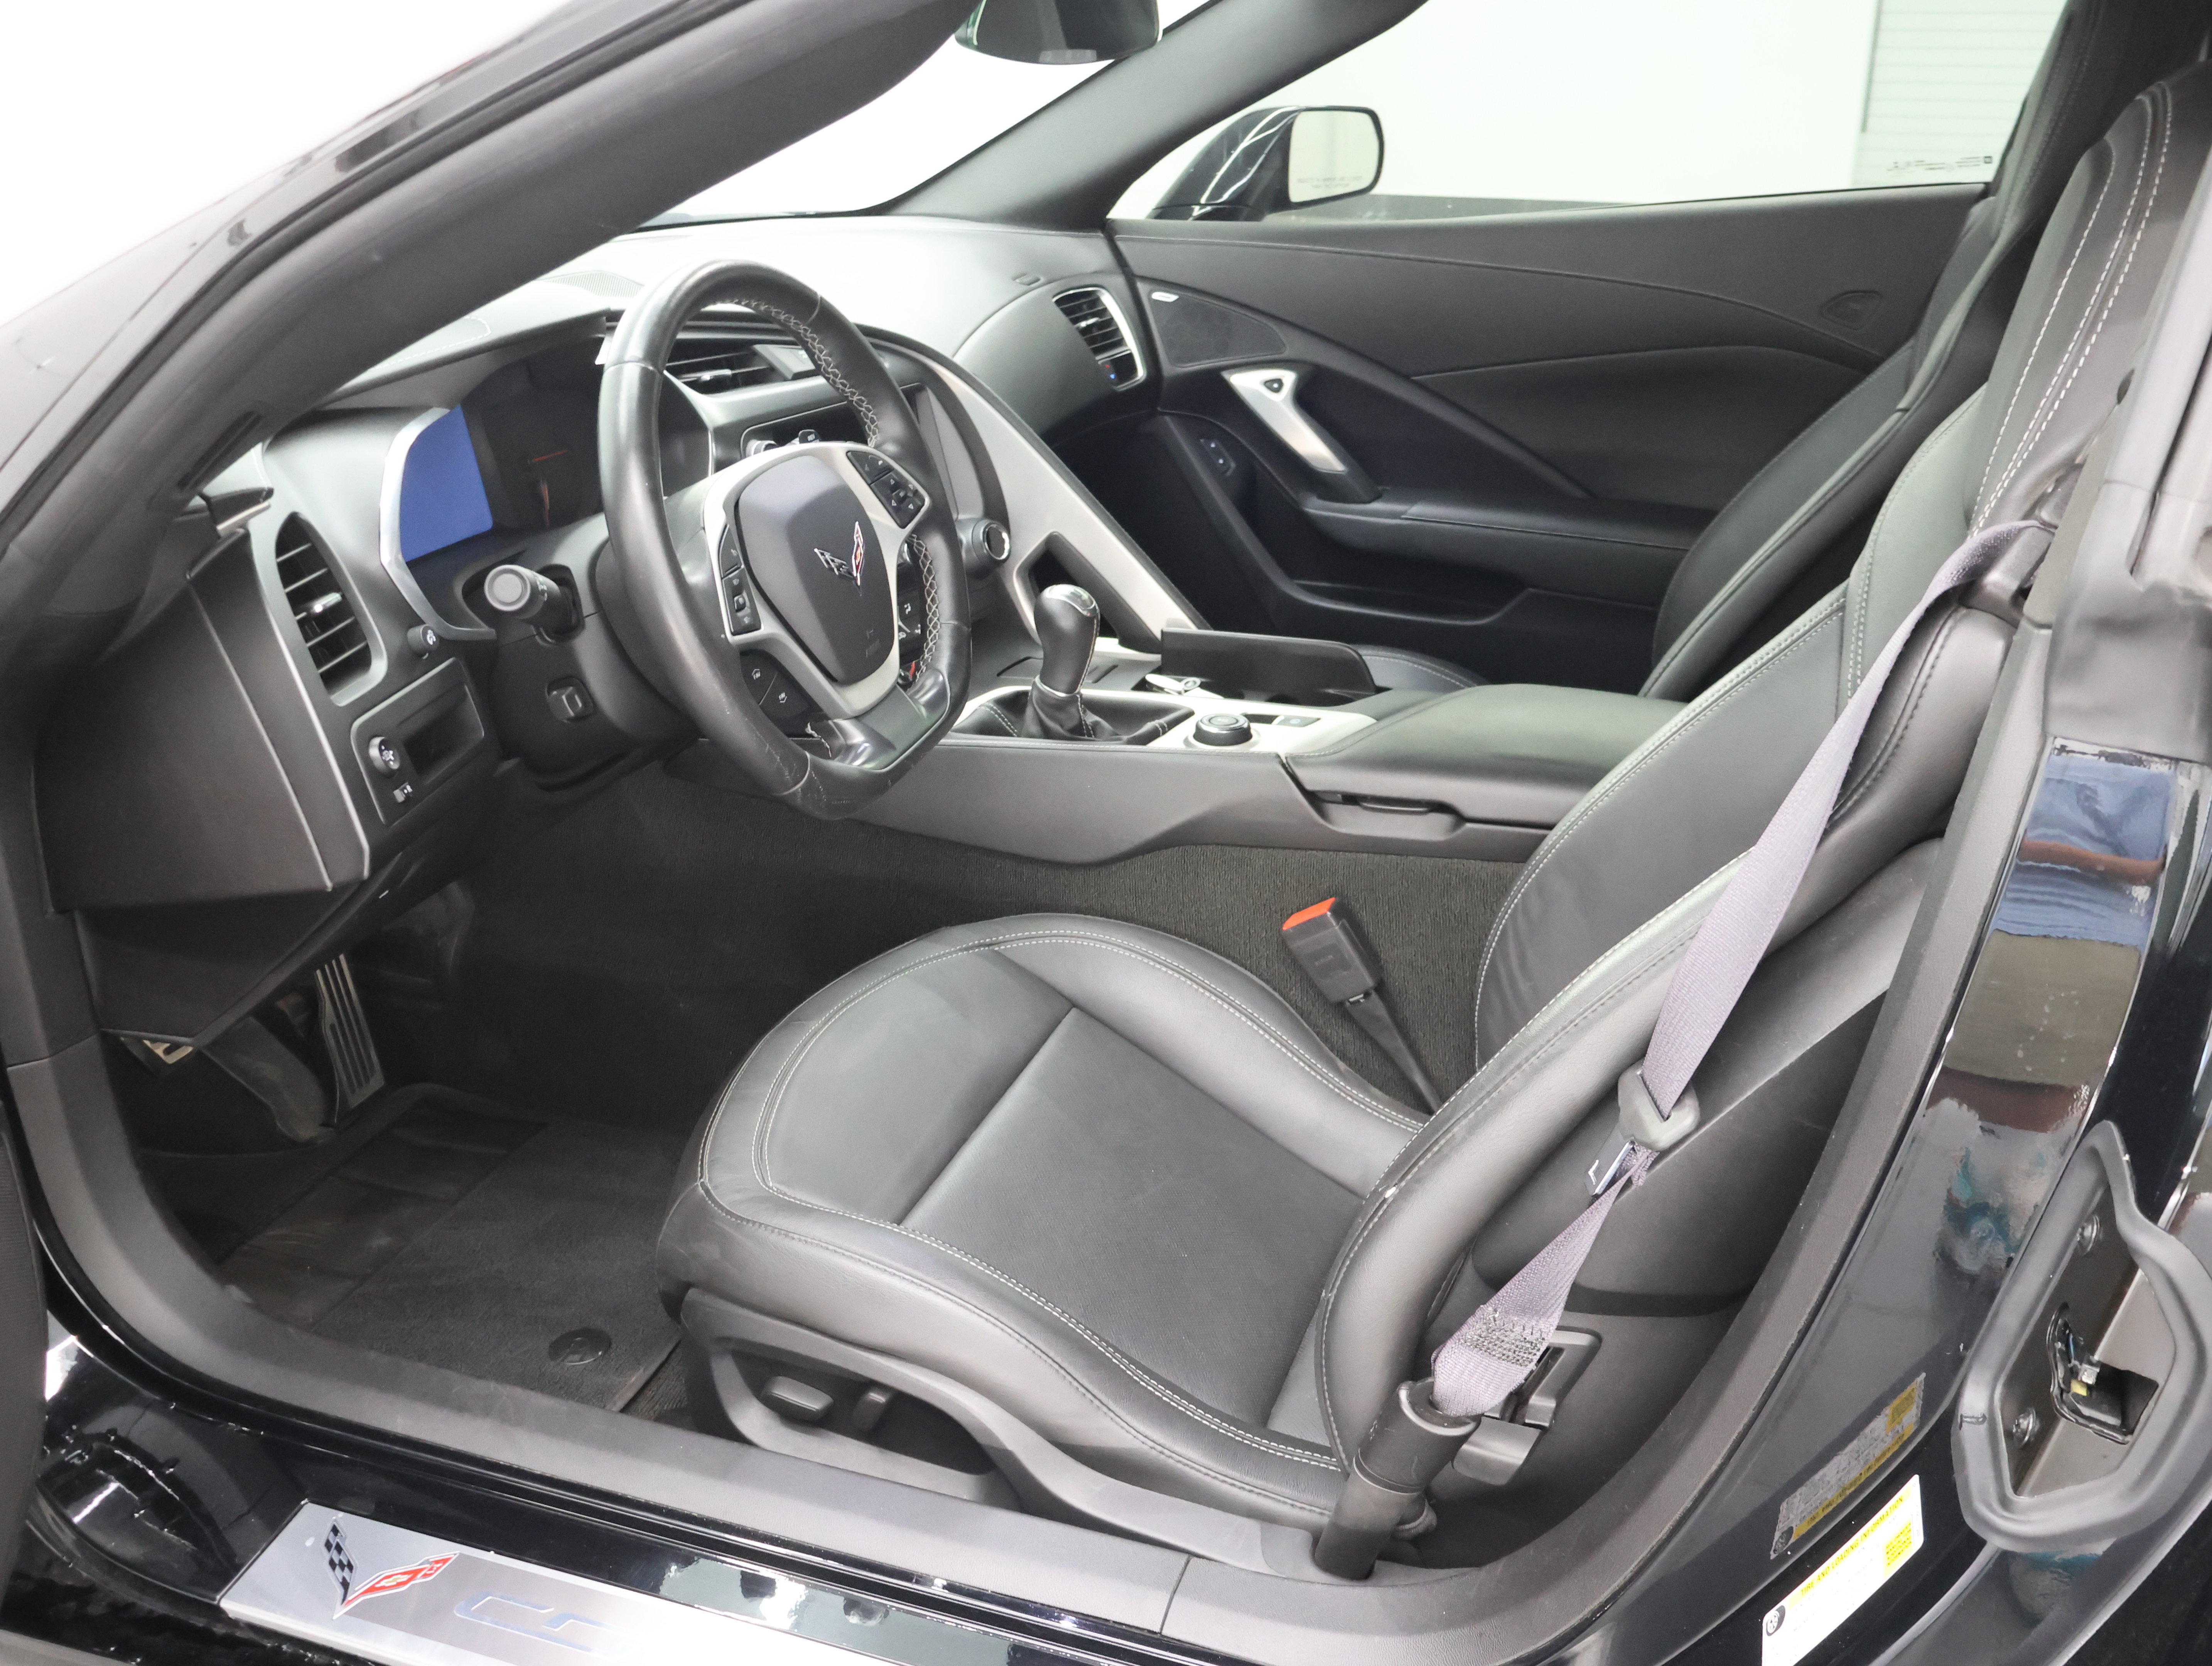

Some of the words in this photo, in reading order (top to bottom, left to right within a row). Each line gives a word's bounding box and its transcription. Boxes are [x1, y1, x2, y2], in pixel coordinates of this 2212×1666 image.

[1800, 1579, 1815, 1597] TIRE
[1817, 1565, 1830, 1583] AND
[1832, 1539, 1859, 1569] LOADING
[1860, 1496, 1903, 1543] INFORMATION
